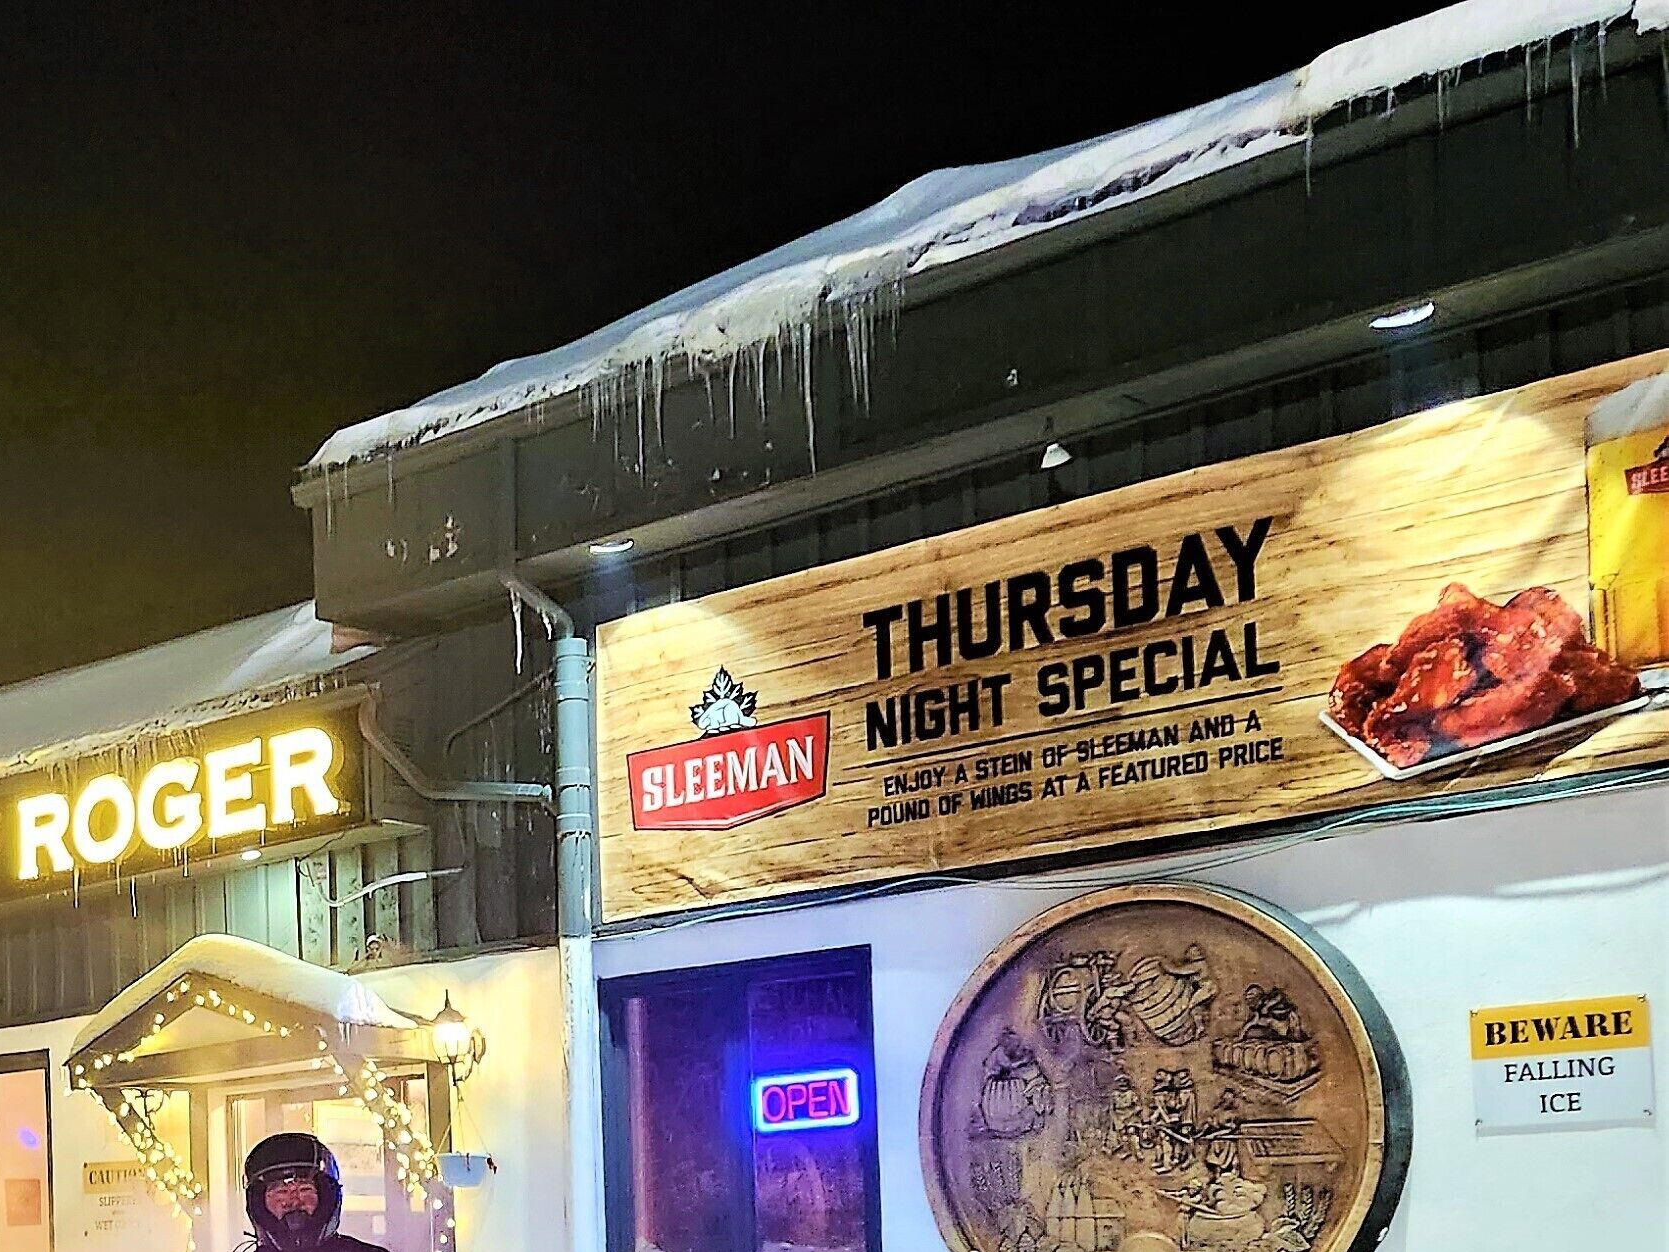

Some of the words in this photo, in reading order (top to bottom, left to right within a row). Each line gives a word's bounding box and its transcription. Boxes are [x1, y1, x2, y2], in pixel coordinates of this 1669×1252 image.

[862, 516, 1275, 681] THURSDAY
[865, 672, 1012, 752] NIGHT
[1037, 622, 1280, 719] SPECIAL
[641, 735, 815, 812] SLEEMAN
[867, 798, 930, 828] POUND
[938, 792, 963, 816] OF
[970, 781, 1032, 811] WINGS
[1041, 775, 1067, 799] AT
[1075, 771, 1090, 794] A
[1099, 751, 1208, 788] FEATURED
[1219, 737, 1284, 769] PRICE
[883, 766, 945, 797] ENJOY
[955, 763, 968, 784] A
[975, 751, 1032, 780] STEIN
[1042, 745, 1067, 769] OF
[1077, 724, 1179, 763] SLEEMAN
[1189, 713, 1235, 743] AND
[1244, 709, 1262, 733] A
[16, 726, 340, 880] ROGER
[1484, 1010, 1633, 1046] BEWARE
[761, 1079, 852, 1124] OPEN
[1504, 1056, 1616, 1083] FALLING
[1539, 1092, 1582, 1114] ICE
[89, 1168, 146, 1185] CAUTION
